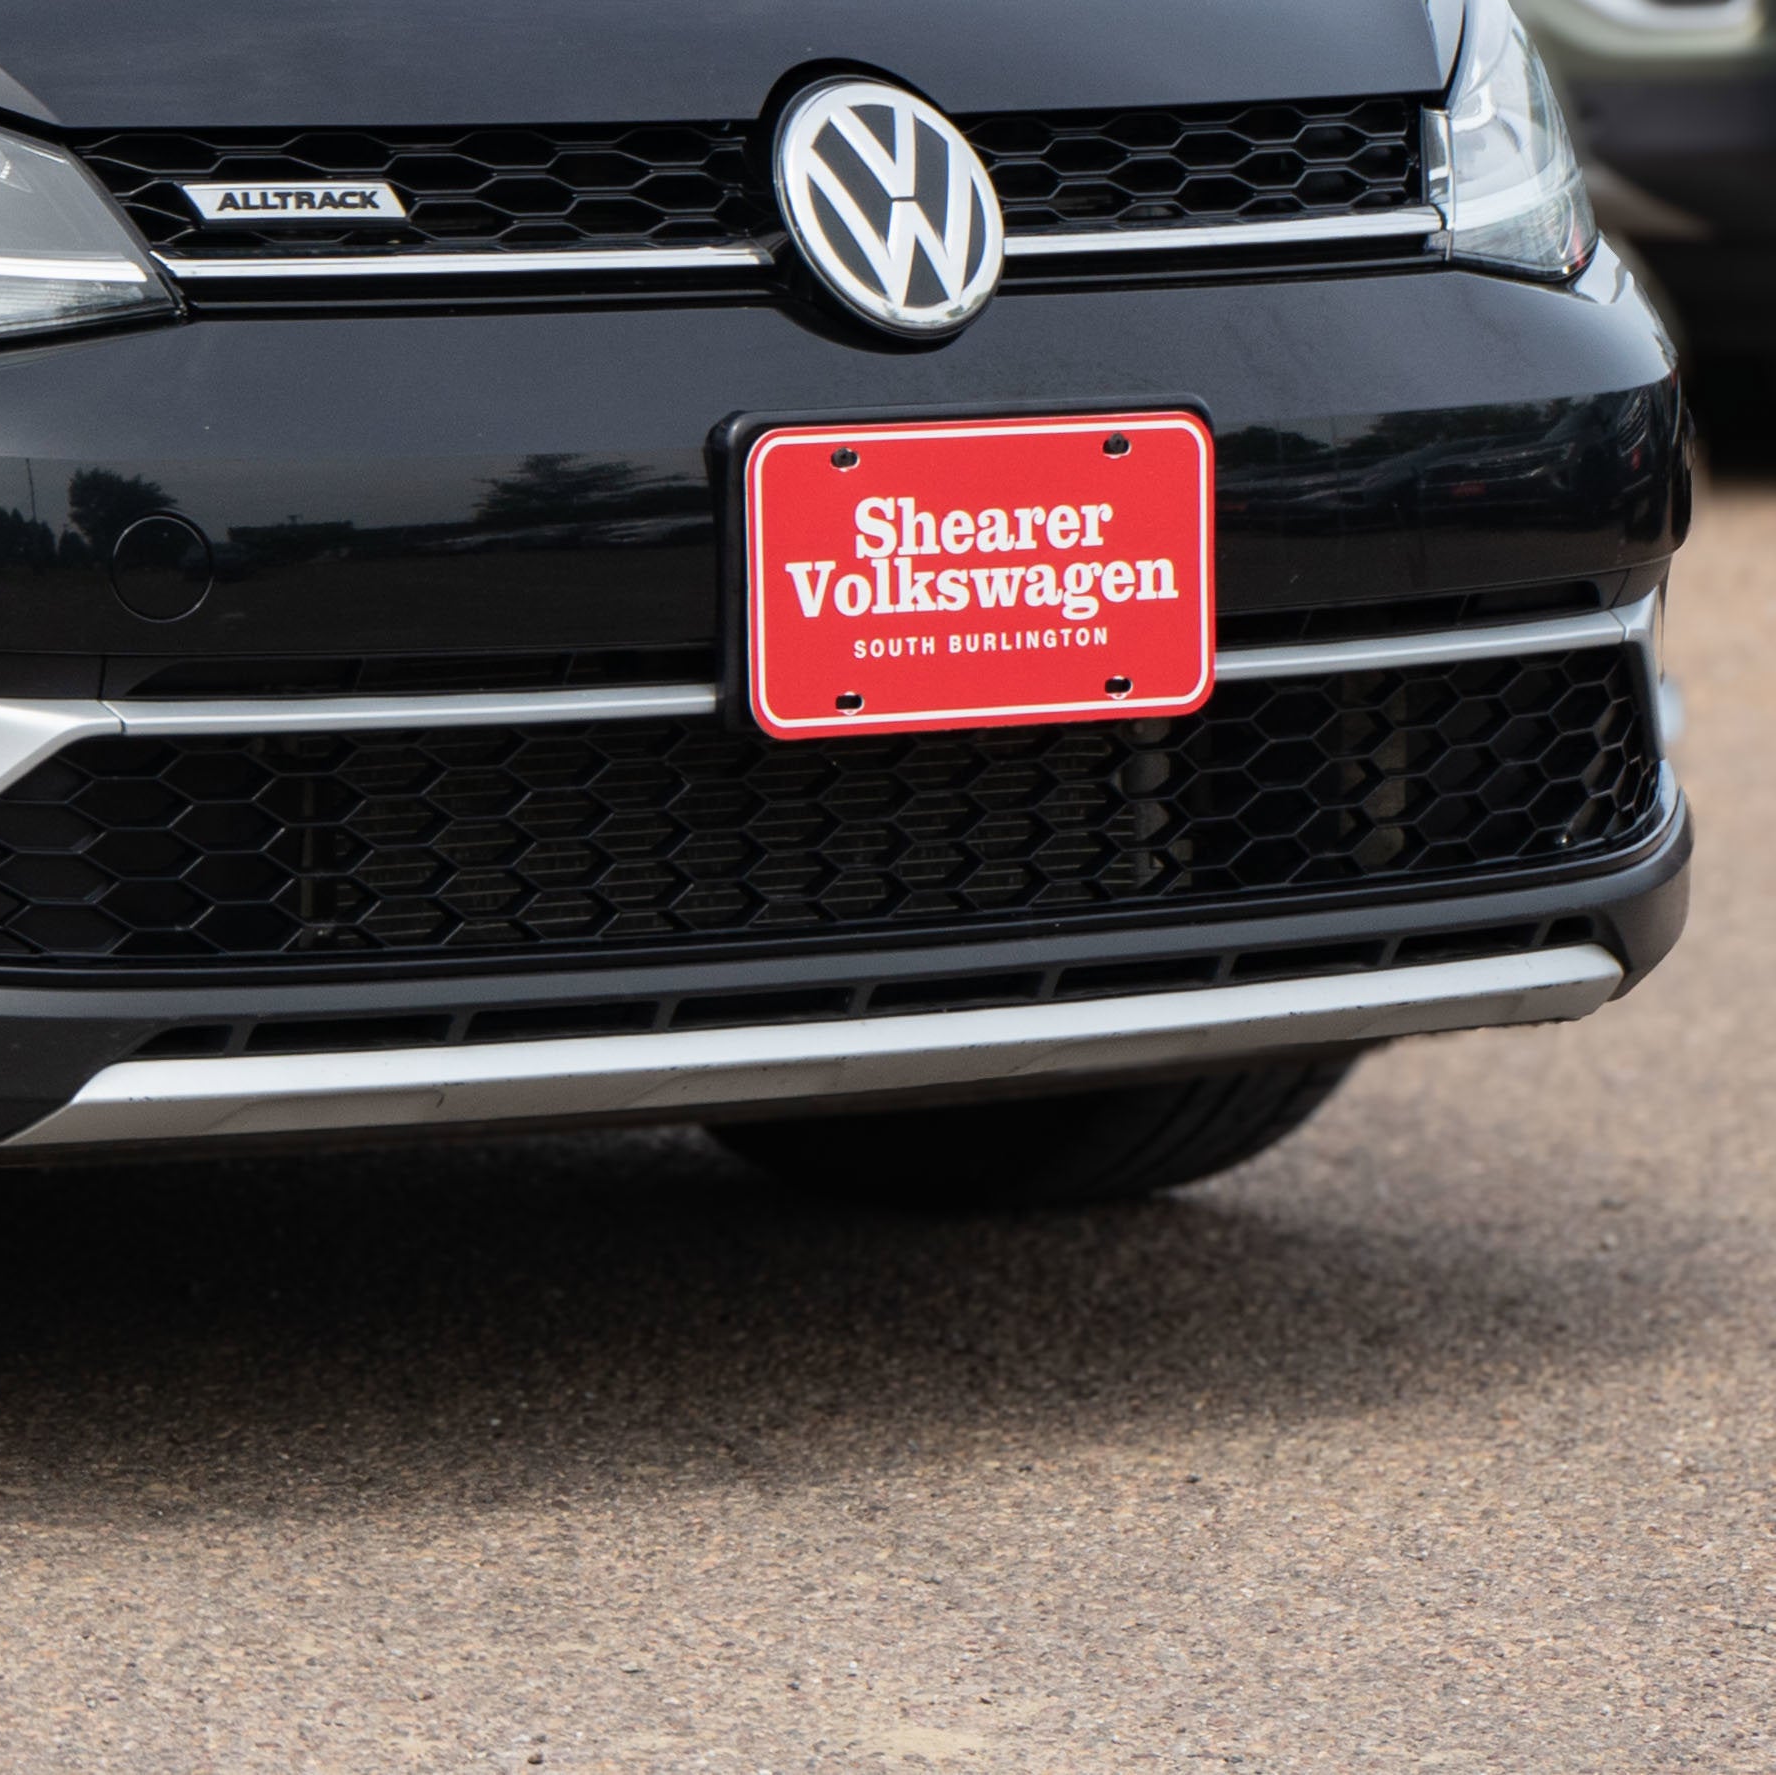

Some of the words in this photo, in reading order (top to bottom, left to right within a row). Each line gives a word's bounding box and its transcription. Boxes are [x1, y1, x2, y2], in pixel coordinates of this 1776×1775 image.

[216, 190, 380, 212] ALLTRACK
[854, 496, 1114, 559] Shearer
[785, 556, 1179, 621] Volkswagen
[853, 635, 936, 659] SOUTH
[948, 626, 1109, 654] BURLINGTON
